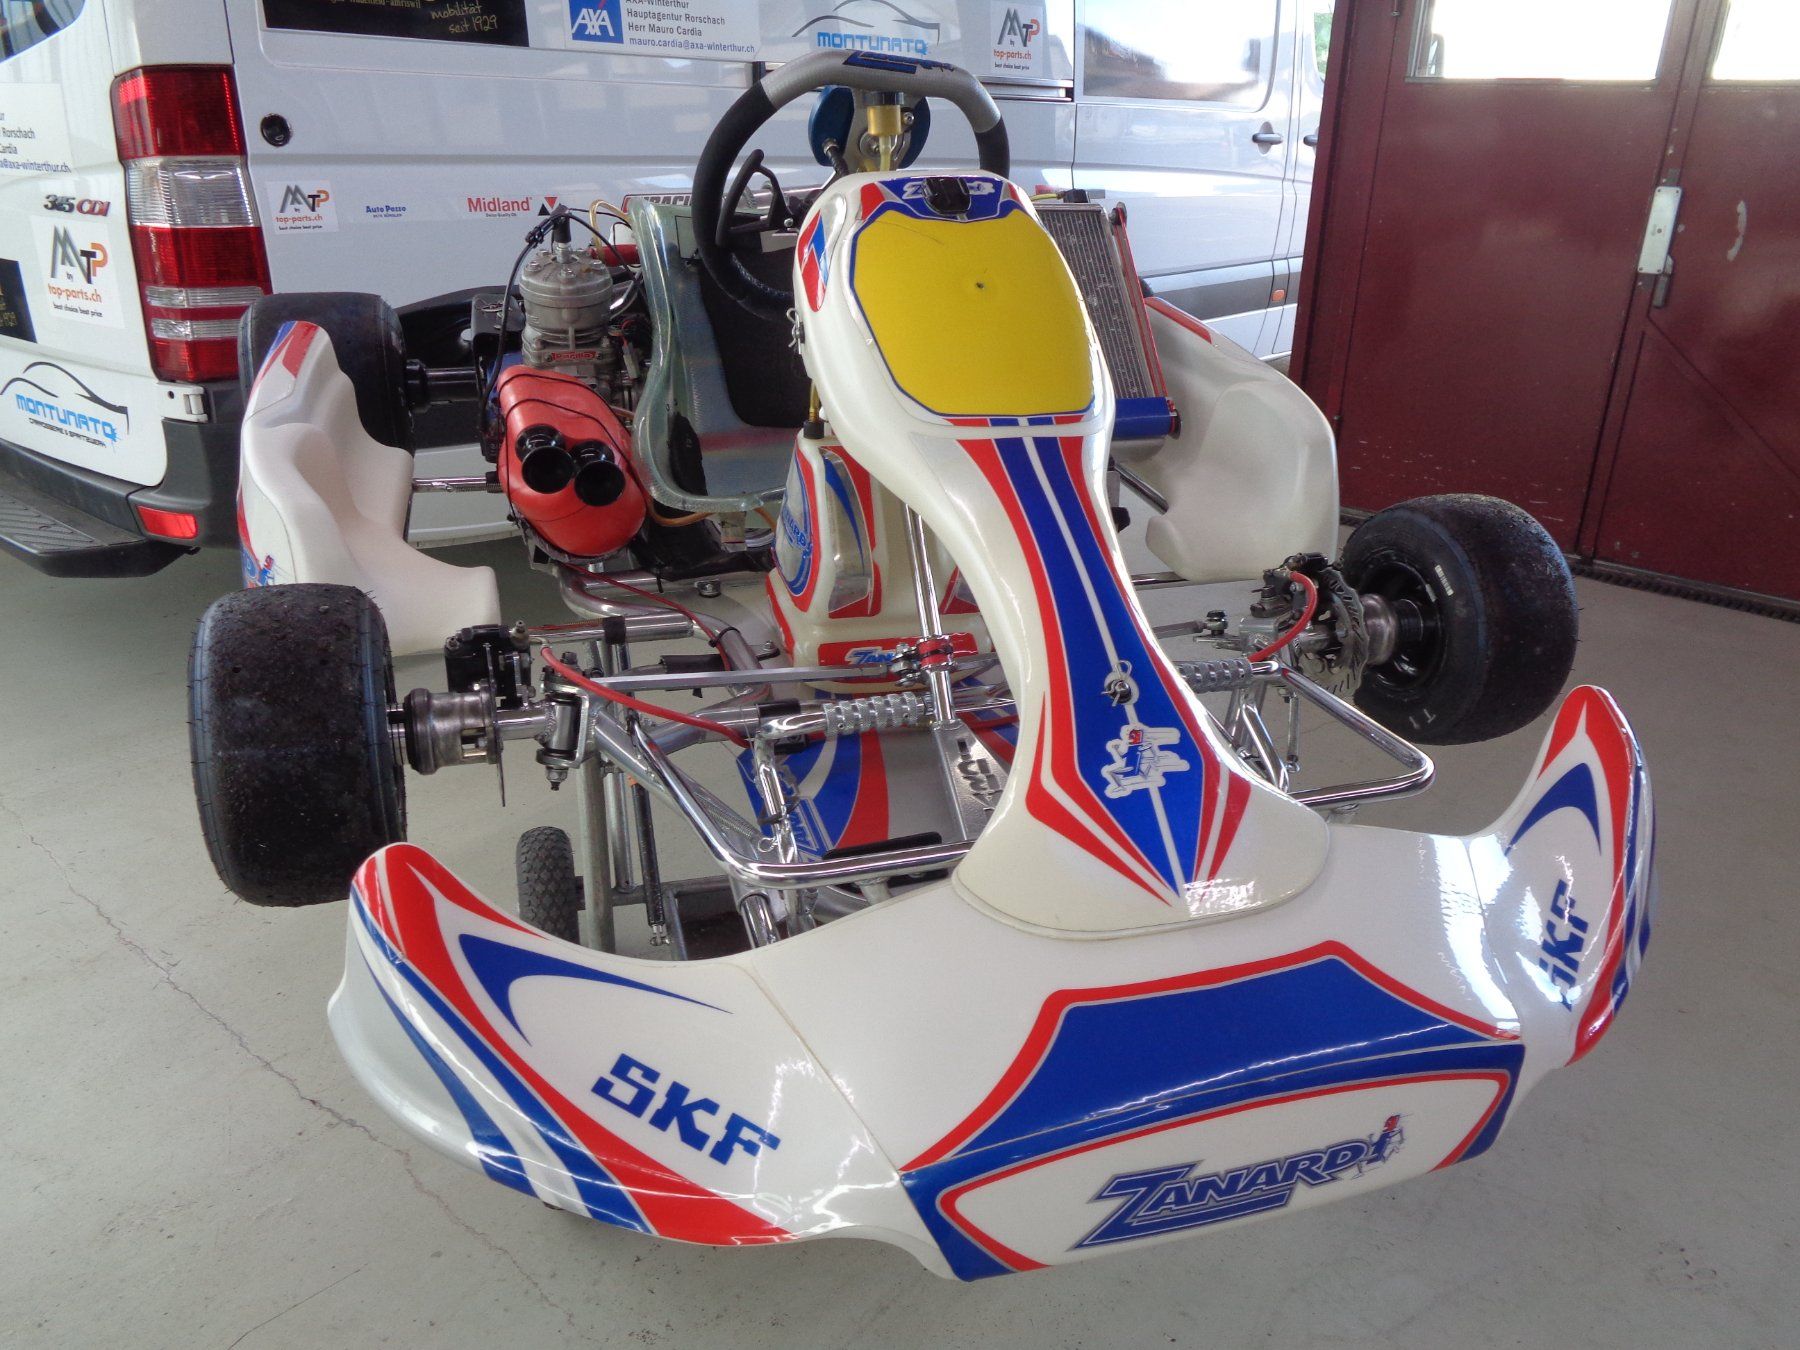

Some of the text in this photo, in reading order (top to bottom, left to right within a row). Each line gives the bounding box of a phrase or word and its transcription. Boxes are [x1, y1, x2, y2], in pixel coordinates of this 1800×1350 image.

[449, 14, 498, 33] seit 1929
[572, 8, 615, 37] AXA
[627, 8, 725, 25] Hauptagentur Rorschach
[628, 22, 702, 37] Herr Mauro Cardia
[629, 38, 755, 53] mauro.cardia@axa-winterthur.ch
[993, 49, 1032, 60] top-parts.ch
[76, 198, 111, 217] CDI
[467, 197, 530, 213] Midland
[275, 213, 323, 224] top-parts.ch
[48, 283, 103, 303] top-parts.ch
[591, 1052, 782, 1166] SKF
